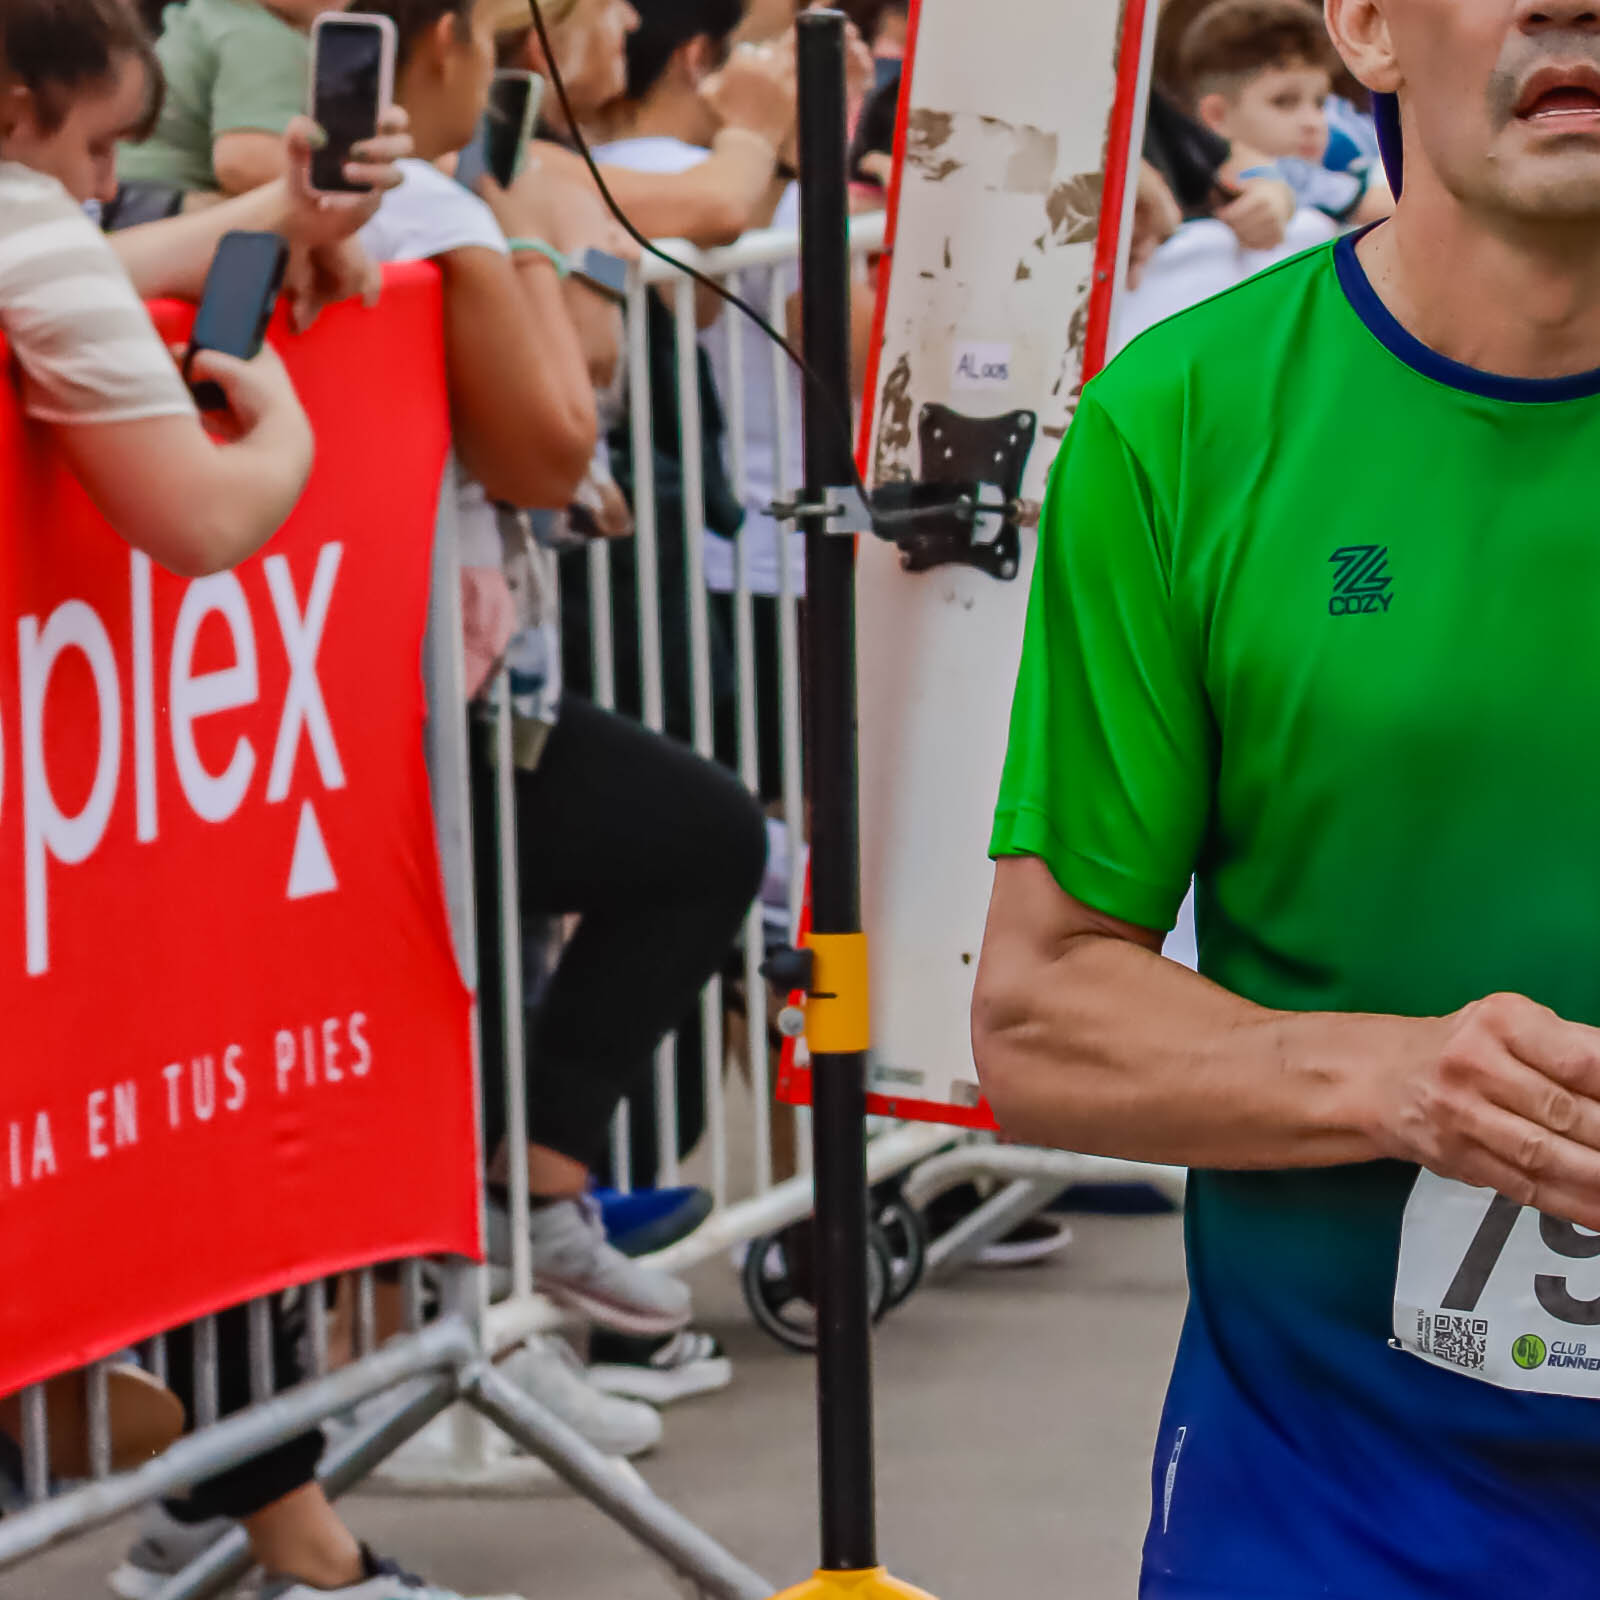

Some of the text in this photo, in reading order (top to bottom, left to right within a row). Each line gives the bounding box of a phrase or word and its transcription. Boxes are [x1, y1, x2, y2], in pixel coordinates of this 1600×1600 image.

[1329, 592, 1394, 616] COZY
[0, 539, 347, 977] plex
[87, 1080, 138, 1158] EN
[162, 1043, 247, 1129] TUS
[275, 1010, 372, 1094] PIES
[1551, 1341, 1587, 1355] CLUB
